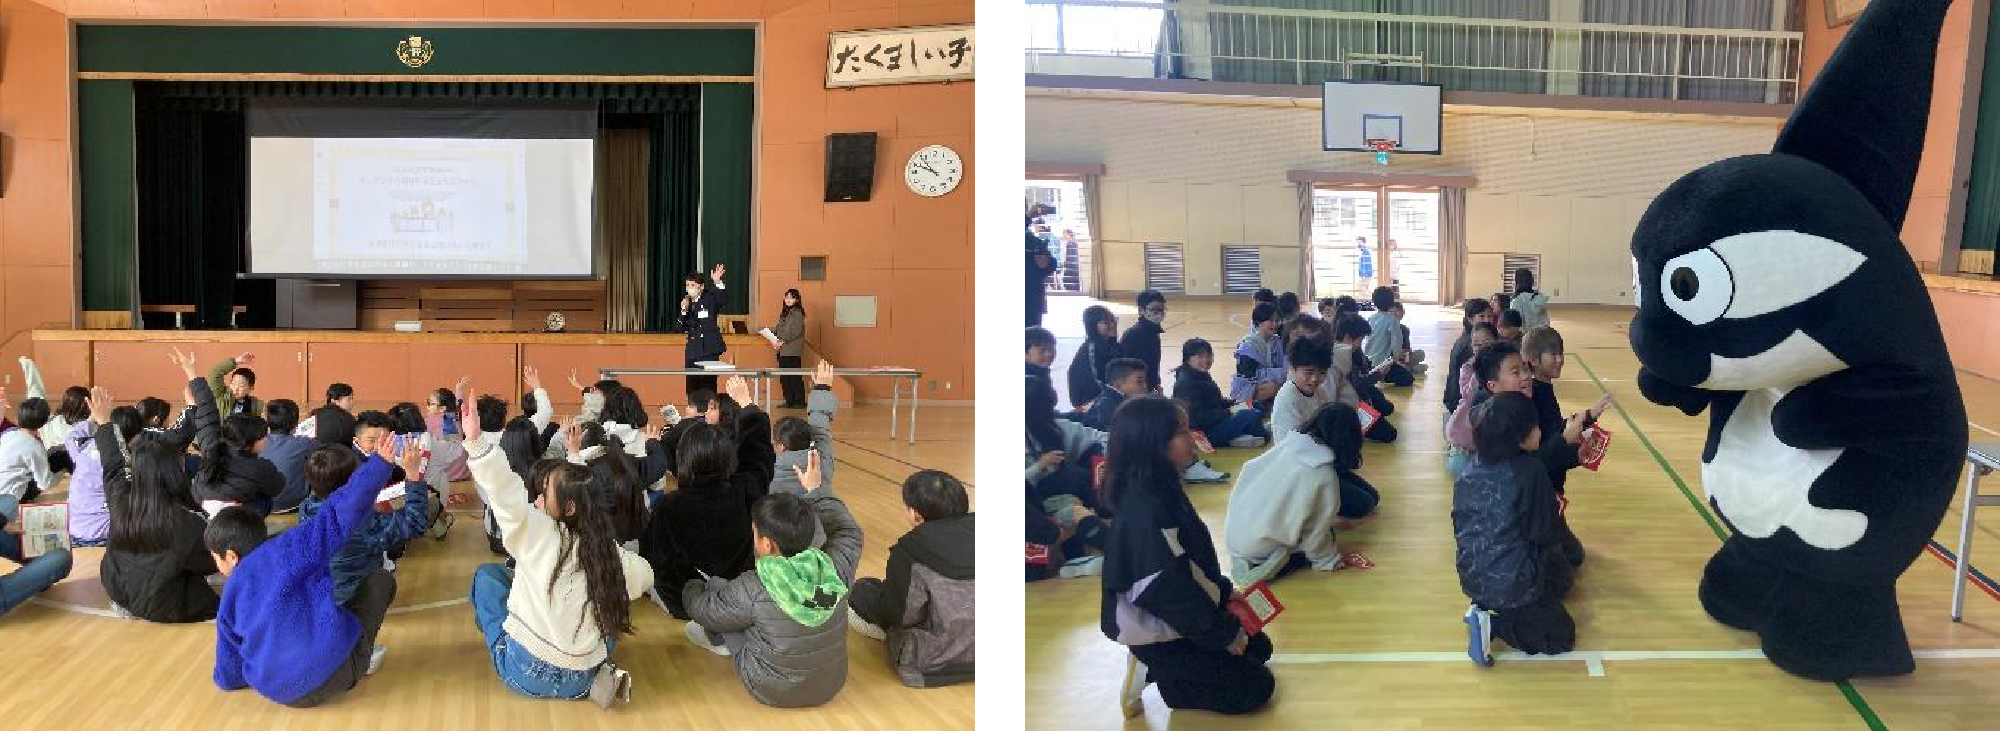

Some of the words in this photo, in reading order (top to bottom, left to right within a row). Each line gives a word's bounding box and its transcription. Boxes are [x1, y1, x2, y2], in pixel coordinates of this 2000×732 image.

[834, 36, 971, 73] たくましい子
